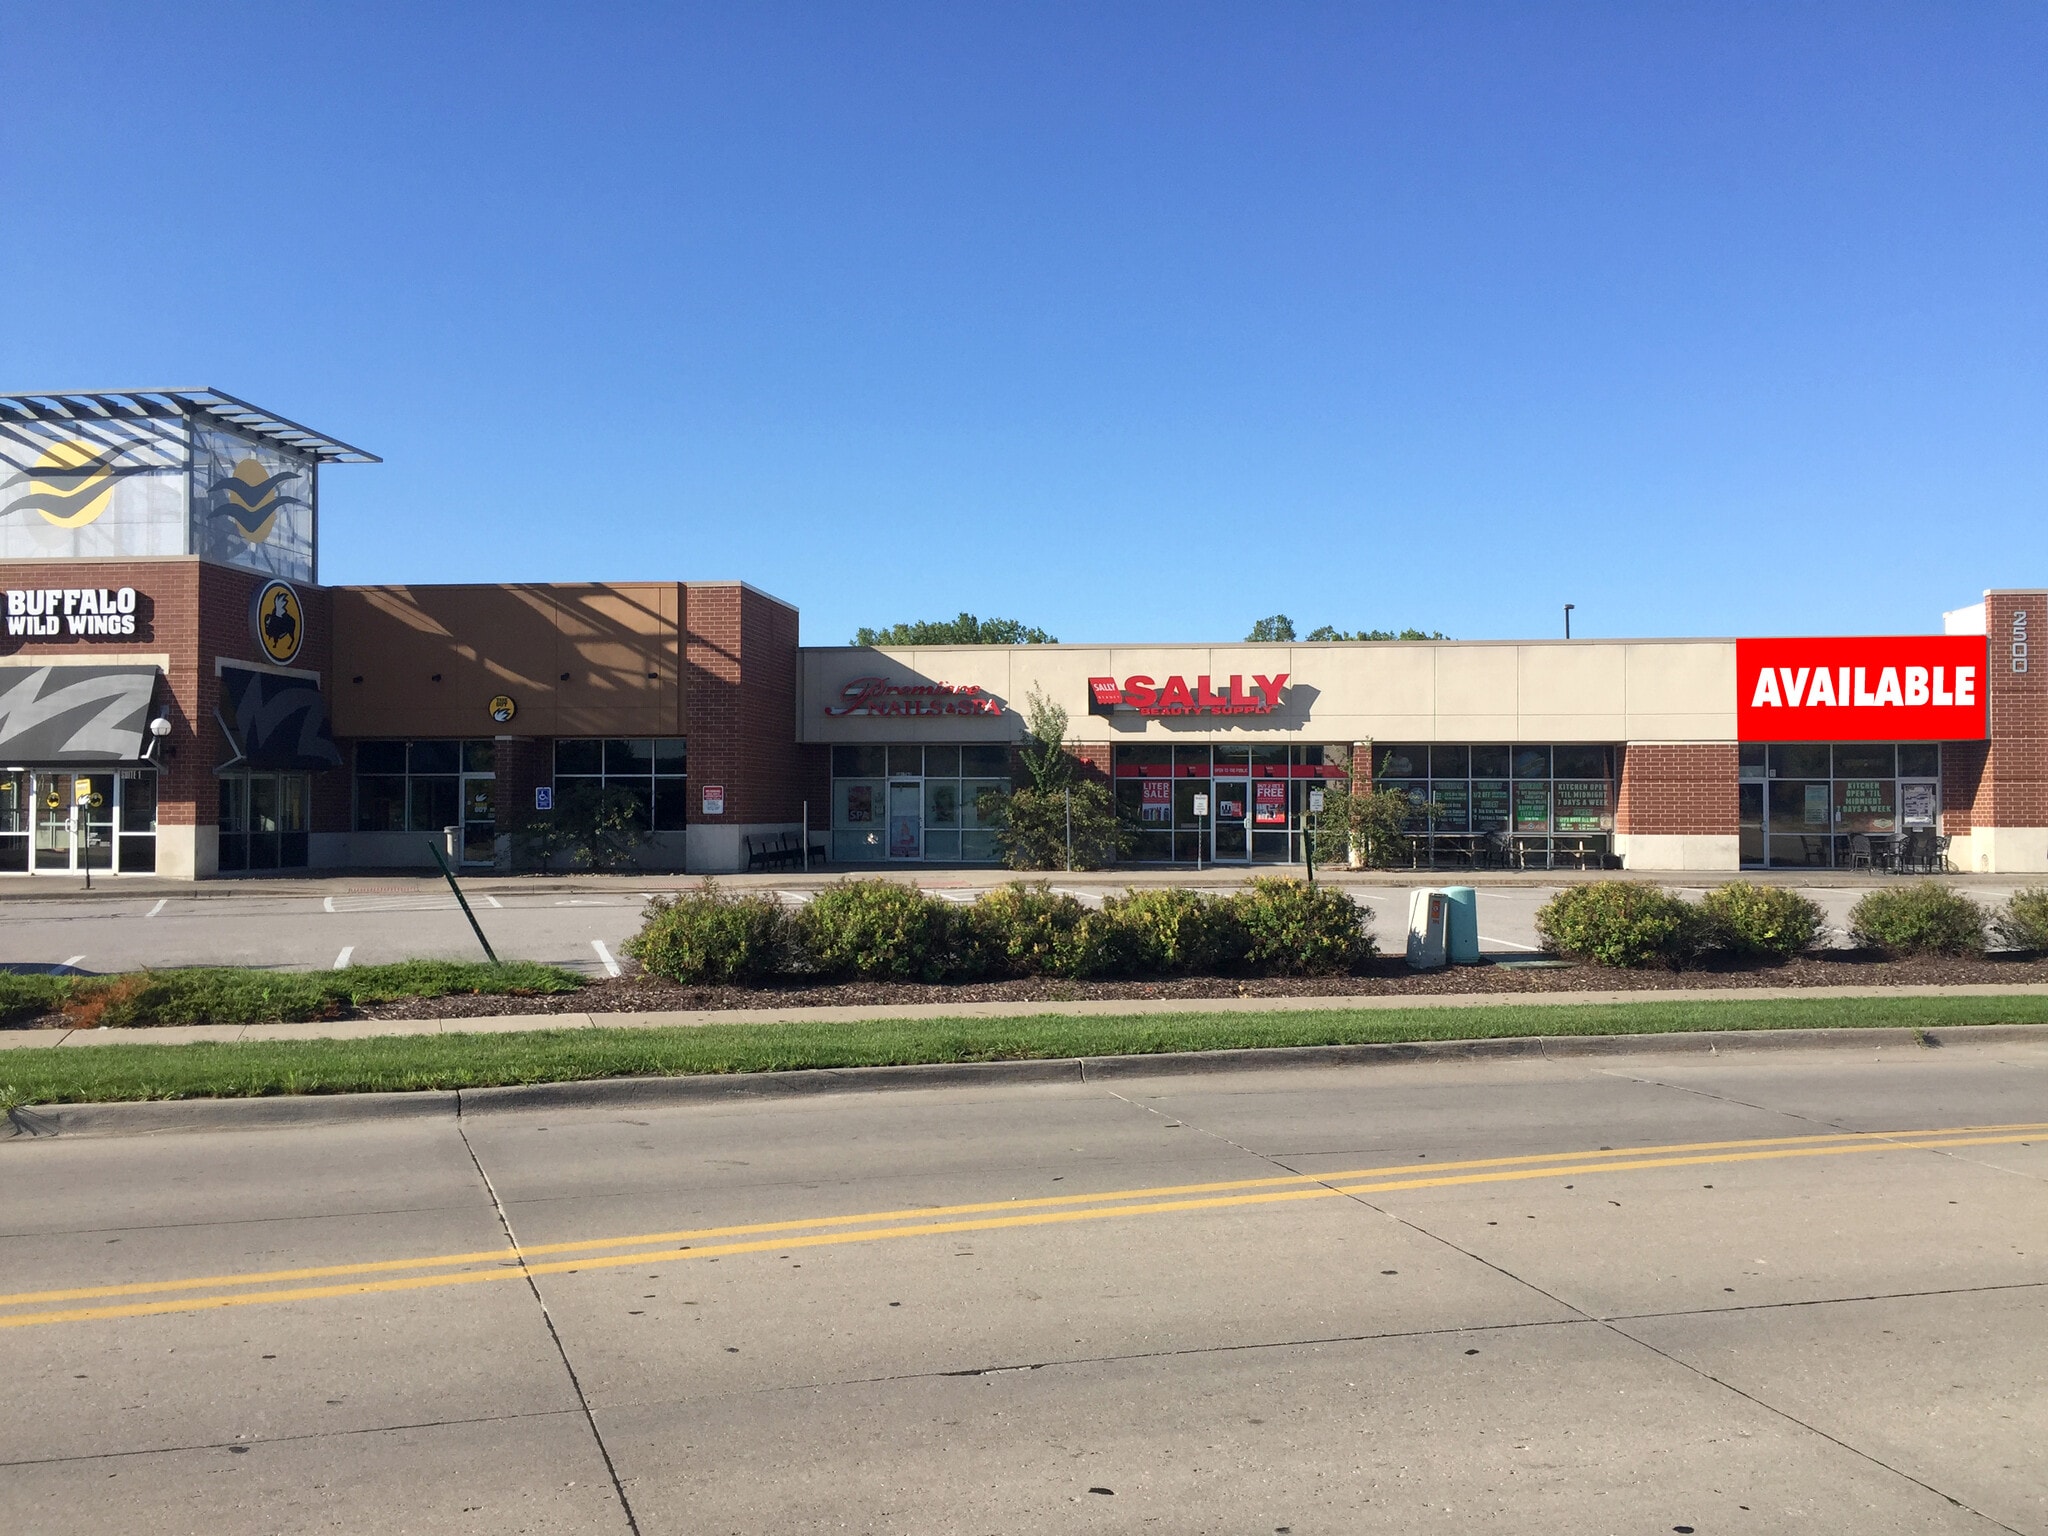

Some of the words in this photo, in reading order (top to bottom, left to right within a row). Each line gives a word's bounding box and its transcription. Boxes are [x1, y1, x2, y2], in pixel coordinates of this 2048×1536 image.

[6, 587, 136, 615] BUFFALO
[6, 616, 60, 635] WILD
[65, 615, 135, 635] WINGS
[2012, 610, 2028, 673] 2500
[1093, 683, 1117, 692] SALLY
[1124, 674, 1290, 707] SALLY
[867, 700, 943, 716] NAILS
[945, 702, 956, 715] &
[957, 698, 1002, 716] SPA
[1140, 706, 1202, 716] BEAUTY
[1211, 706, 1273, 715] SUPPLY
[1143, 782, 1170, 790] LITER
[1558, 783, 1588, 791] KITCHEN
[1589, 783, 1608, 791] OPEN
[1847, 782, 1880, 790] KITCHEN
[1143, 790, 1169, 798] SALE
[1257, 788, 1284, 797] FREE
[1845, 797, 1882, 805] MIDNIGHT
[1843, 805, 1862, 813] DAYS
[1869, 805, 1892, 813] WEEK
